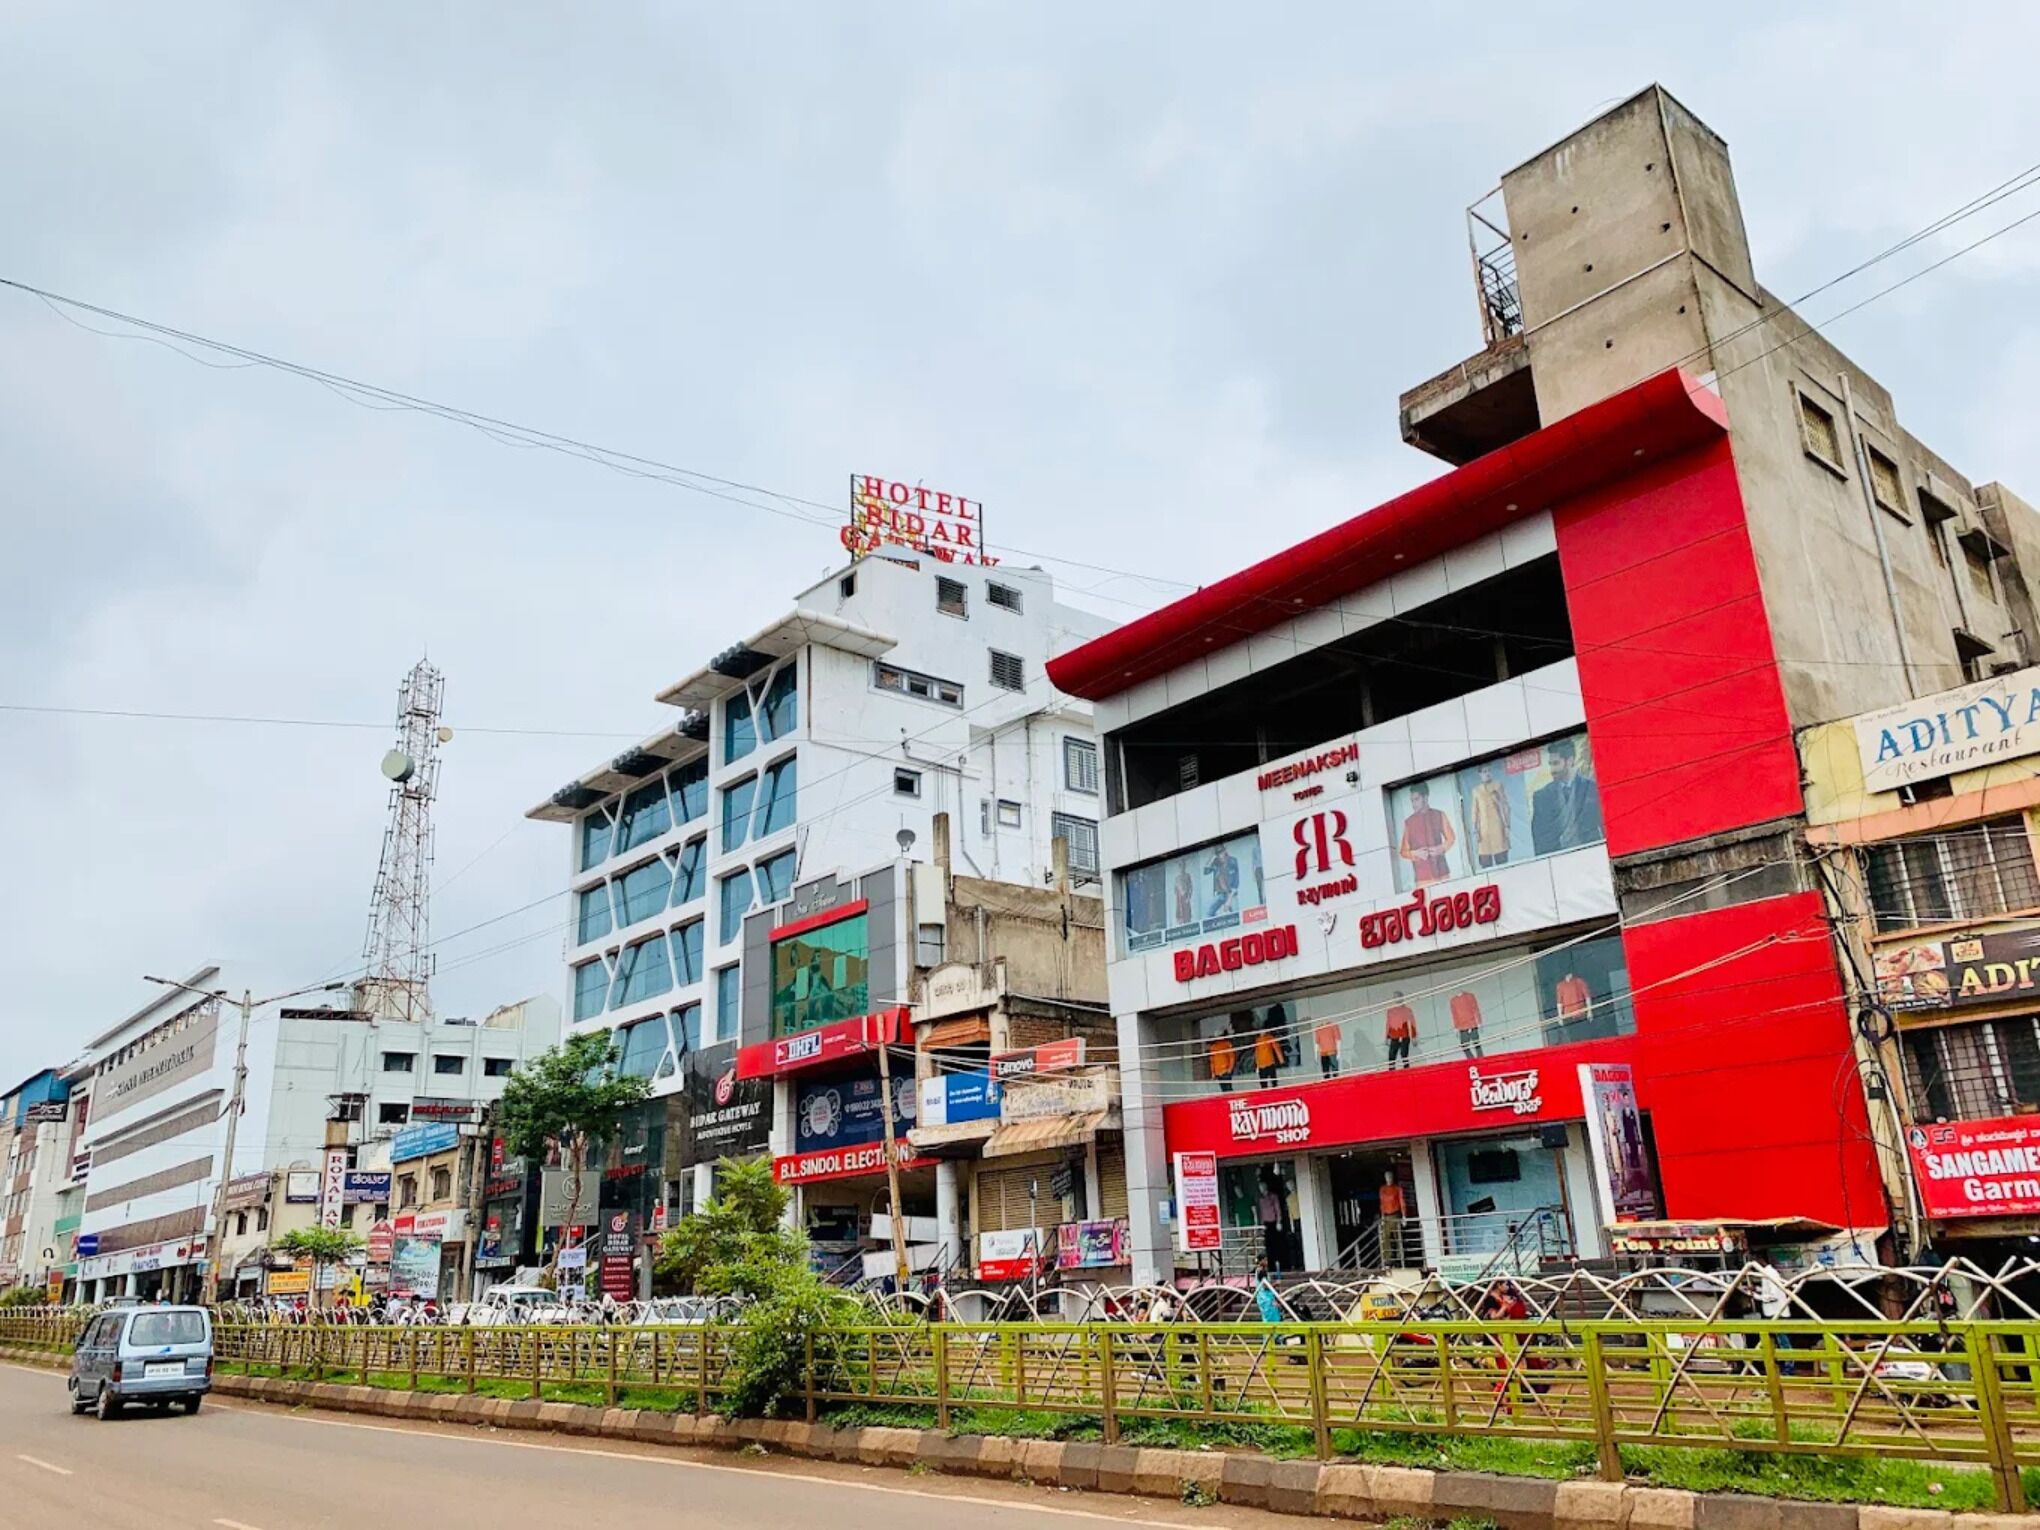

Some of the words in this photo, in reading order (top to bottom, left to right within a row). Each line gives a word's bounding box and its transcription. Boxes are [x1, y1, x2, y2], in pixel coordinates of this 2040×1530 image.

[864, 475, 974, 519] HOTEL
[866, 503, 976, 547] BIDAR
[1258, 743, 1359, 791] MEENAKSHI
[1885, 728, 2022, 779] Restaurant
[1293, 785, 1324, 801] TOWER
[1296, 873, 1358, 906] Raymond
[1174, 924, 1298, 983] BAGODI
[1958, 960, 2040, 997] ADI
[789, 1034, 820, 1059] DHFL
[998, 1057, 1034, 1076] Lenovo
[690, 1111, 717, 1129] BIDAR
[718, 1101, 761, 1122] GATEWAY
[1229, 1100, 1247, 1111] THE
[1231, 1100, 1309, 1140] Raymond
[1276, 1128, 1311, 1144] SHOP
[328, 1155, 343, 1204] ROYAL
[1925, 1146, 2040, 1180] SANGAME
[1963, 1178, 2040, 1201] Garm
[1612, 1238, 1653, 1251] Tea
[1658, 1235, 1720, 1251] Point
